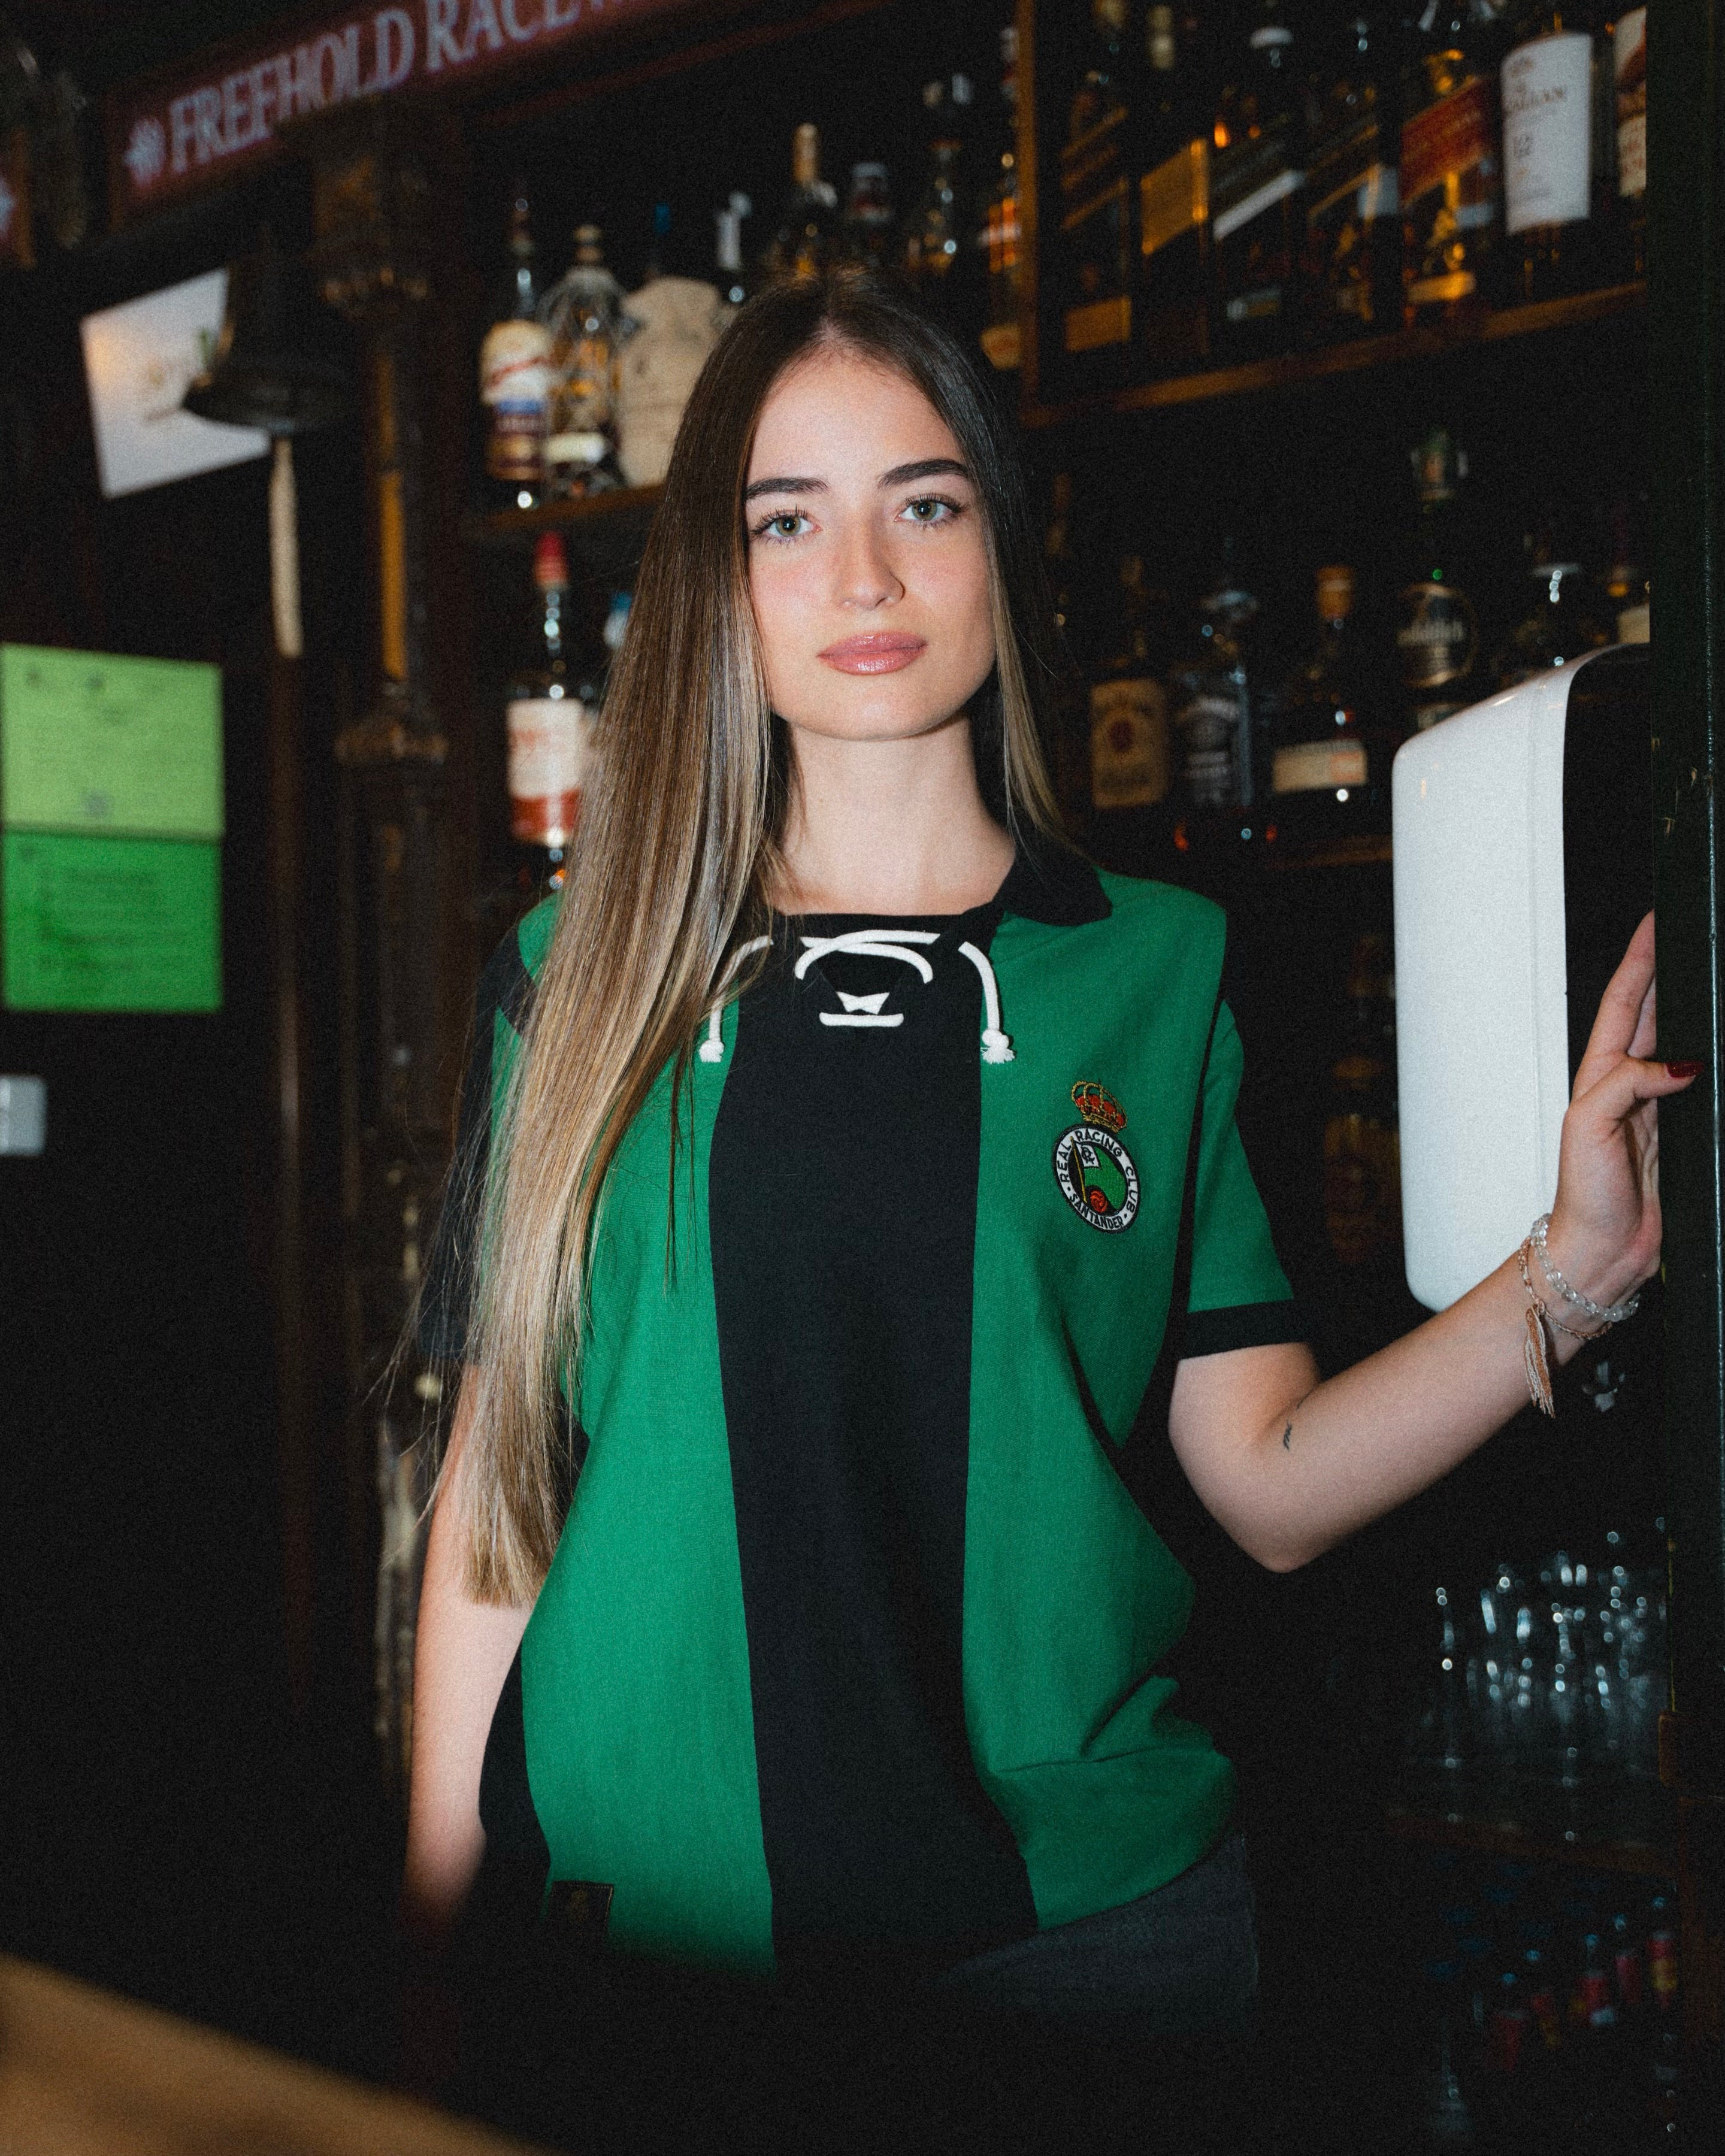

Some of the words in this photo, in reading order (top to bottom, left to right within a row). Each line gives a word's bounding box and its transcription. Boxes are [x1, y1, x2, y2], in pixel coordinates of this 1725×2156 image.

[170, 9, 416, 173] FREEHOLD
[1058, 1143, 1072, 1183] REAL
[1075, 1130, 1123, 1157] RACING
[1124, 1166, 1139, 1213] CLUB
[1069, 1194, 1124, 1228] SANTANDER
